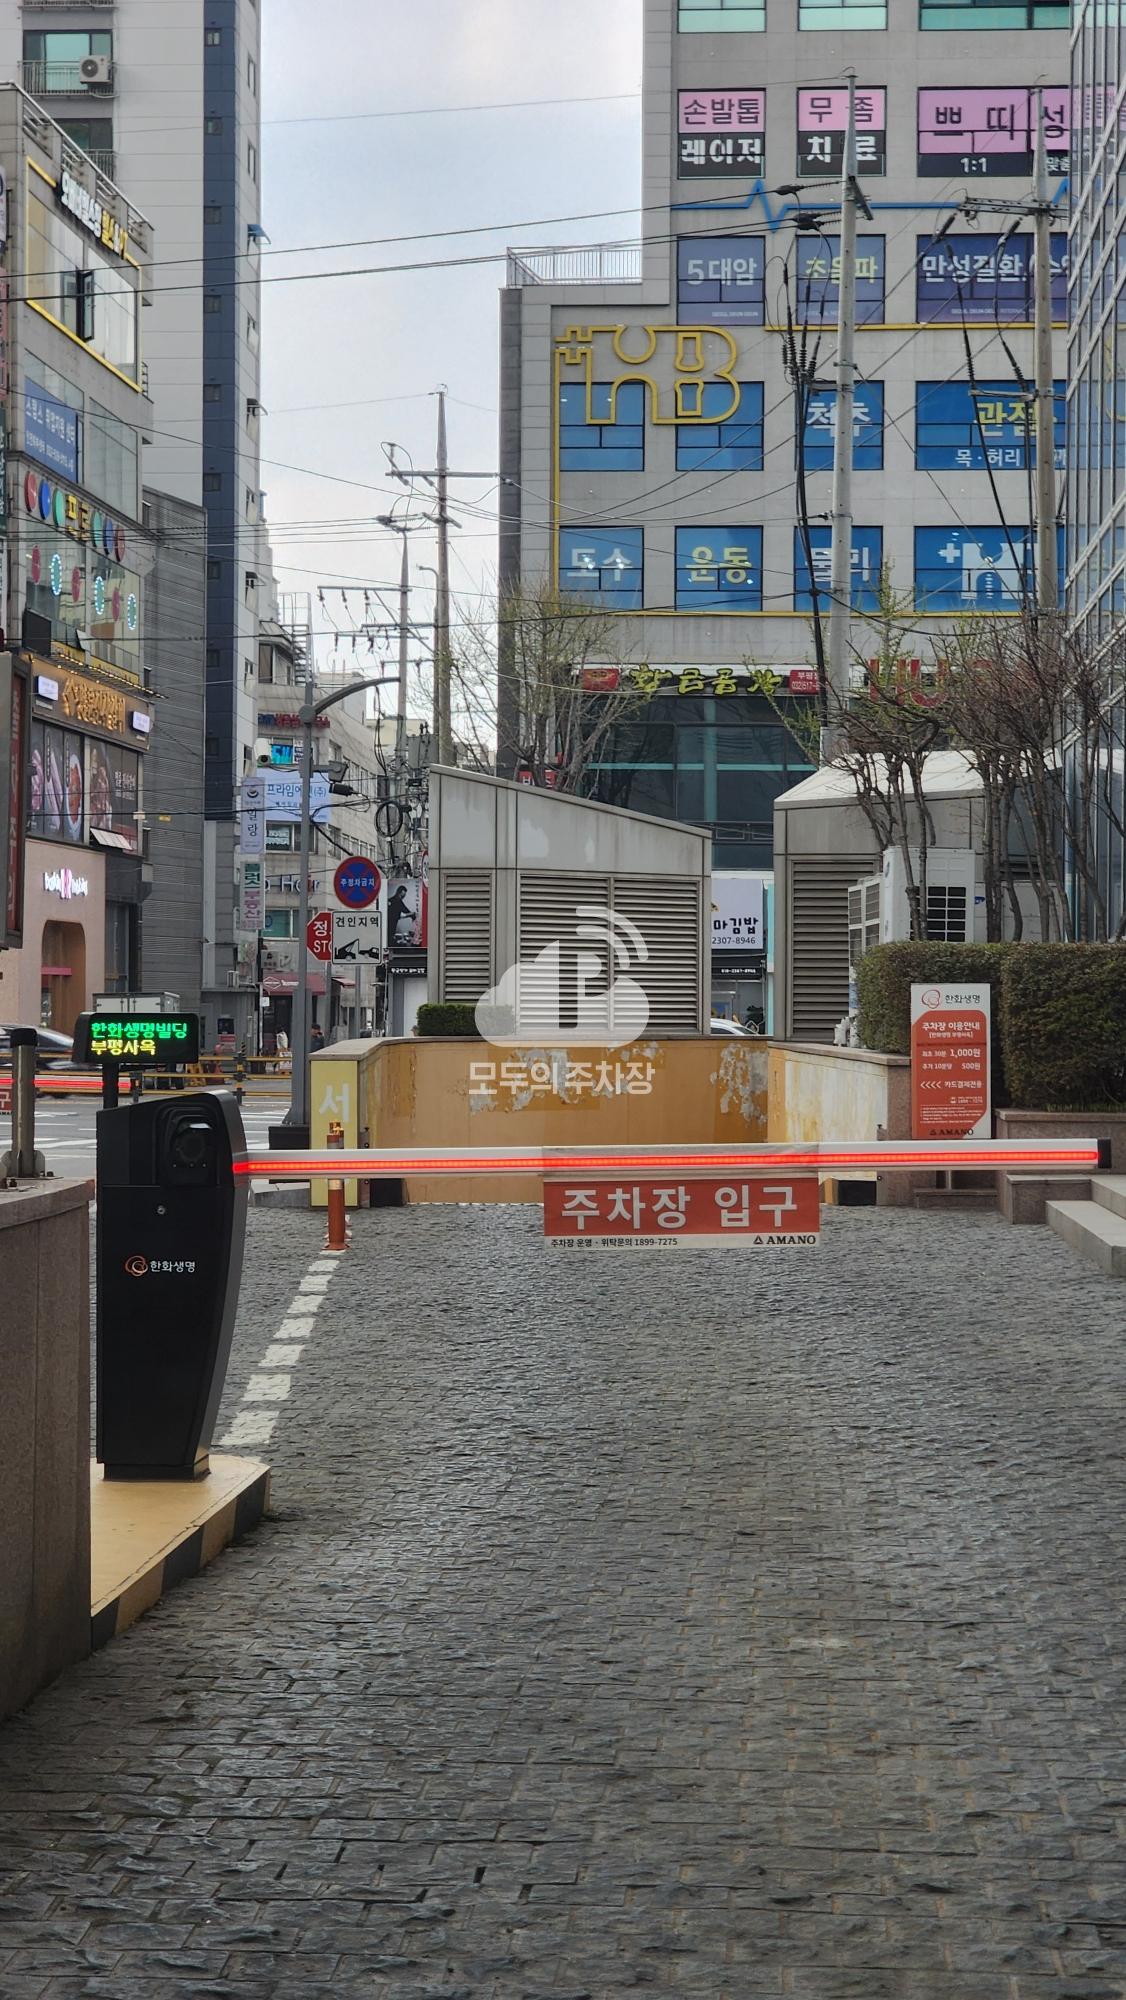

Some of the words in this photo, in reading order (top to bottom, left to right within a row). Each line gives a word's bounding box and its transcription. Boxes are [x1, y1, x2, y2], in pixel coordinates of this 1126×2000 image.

[683, 98, 760, 125] 손발톱
[681, 136, 761, 165] 레이저
[806, 136, 878, 163] 치료
[960, 157, 987, 173] 1:1
[567, 548, 633, 582] 도수
[685, 546, 752, 584] 운동
[336, 917, 379, 928] 견인지역
[945, 994, 981, 1004] 한화생명
[91, 1022, 188, 1039] 한화생명빌딩
[922, 1022, 946, 1031] 주차장
[948, 1021, 980, 1031] 이용안내
[91, 1039, 156, 1055] 부평사옥
[949, 1048, 981, 1059] 1,000원
[961, 1062, 981, 1071] 500원
[939, 1128, 974, 1136] AMANO
[561, 1186, 691, 1230] 주차장
[714, 1184, 798, 1228] 입구
[551, 1239, 574, 1248] 주차장
[577, 1239, 593, 1248] 운영
[601, 1238, 633, 1247] 위탁문의
[634, 1237, 678, 1246] 1899-7275
[766, 1234, 817, 1246] AMANO
[150, 1260, 196, 1273] 한화생명
